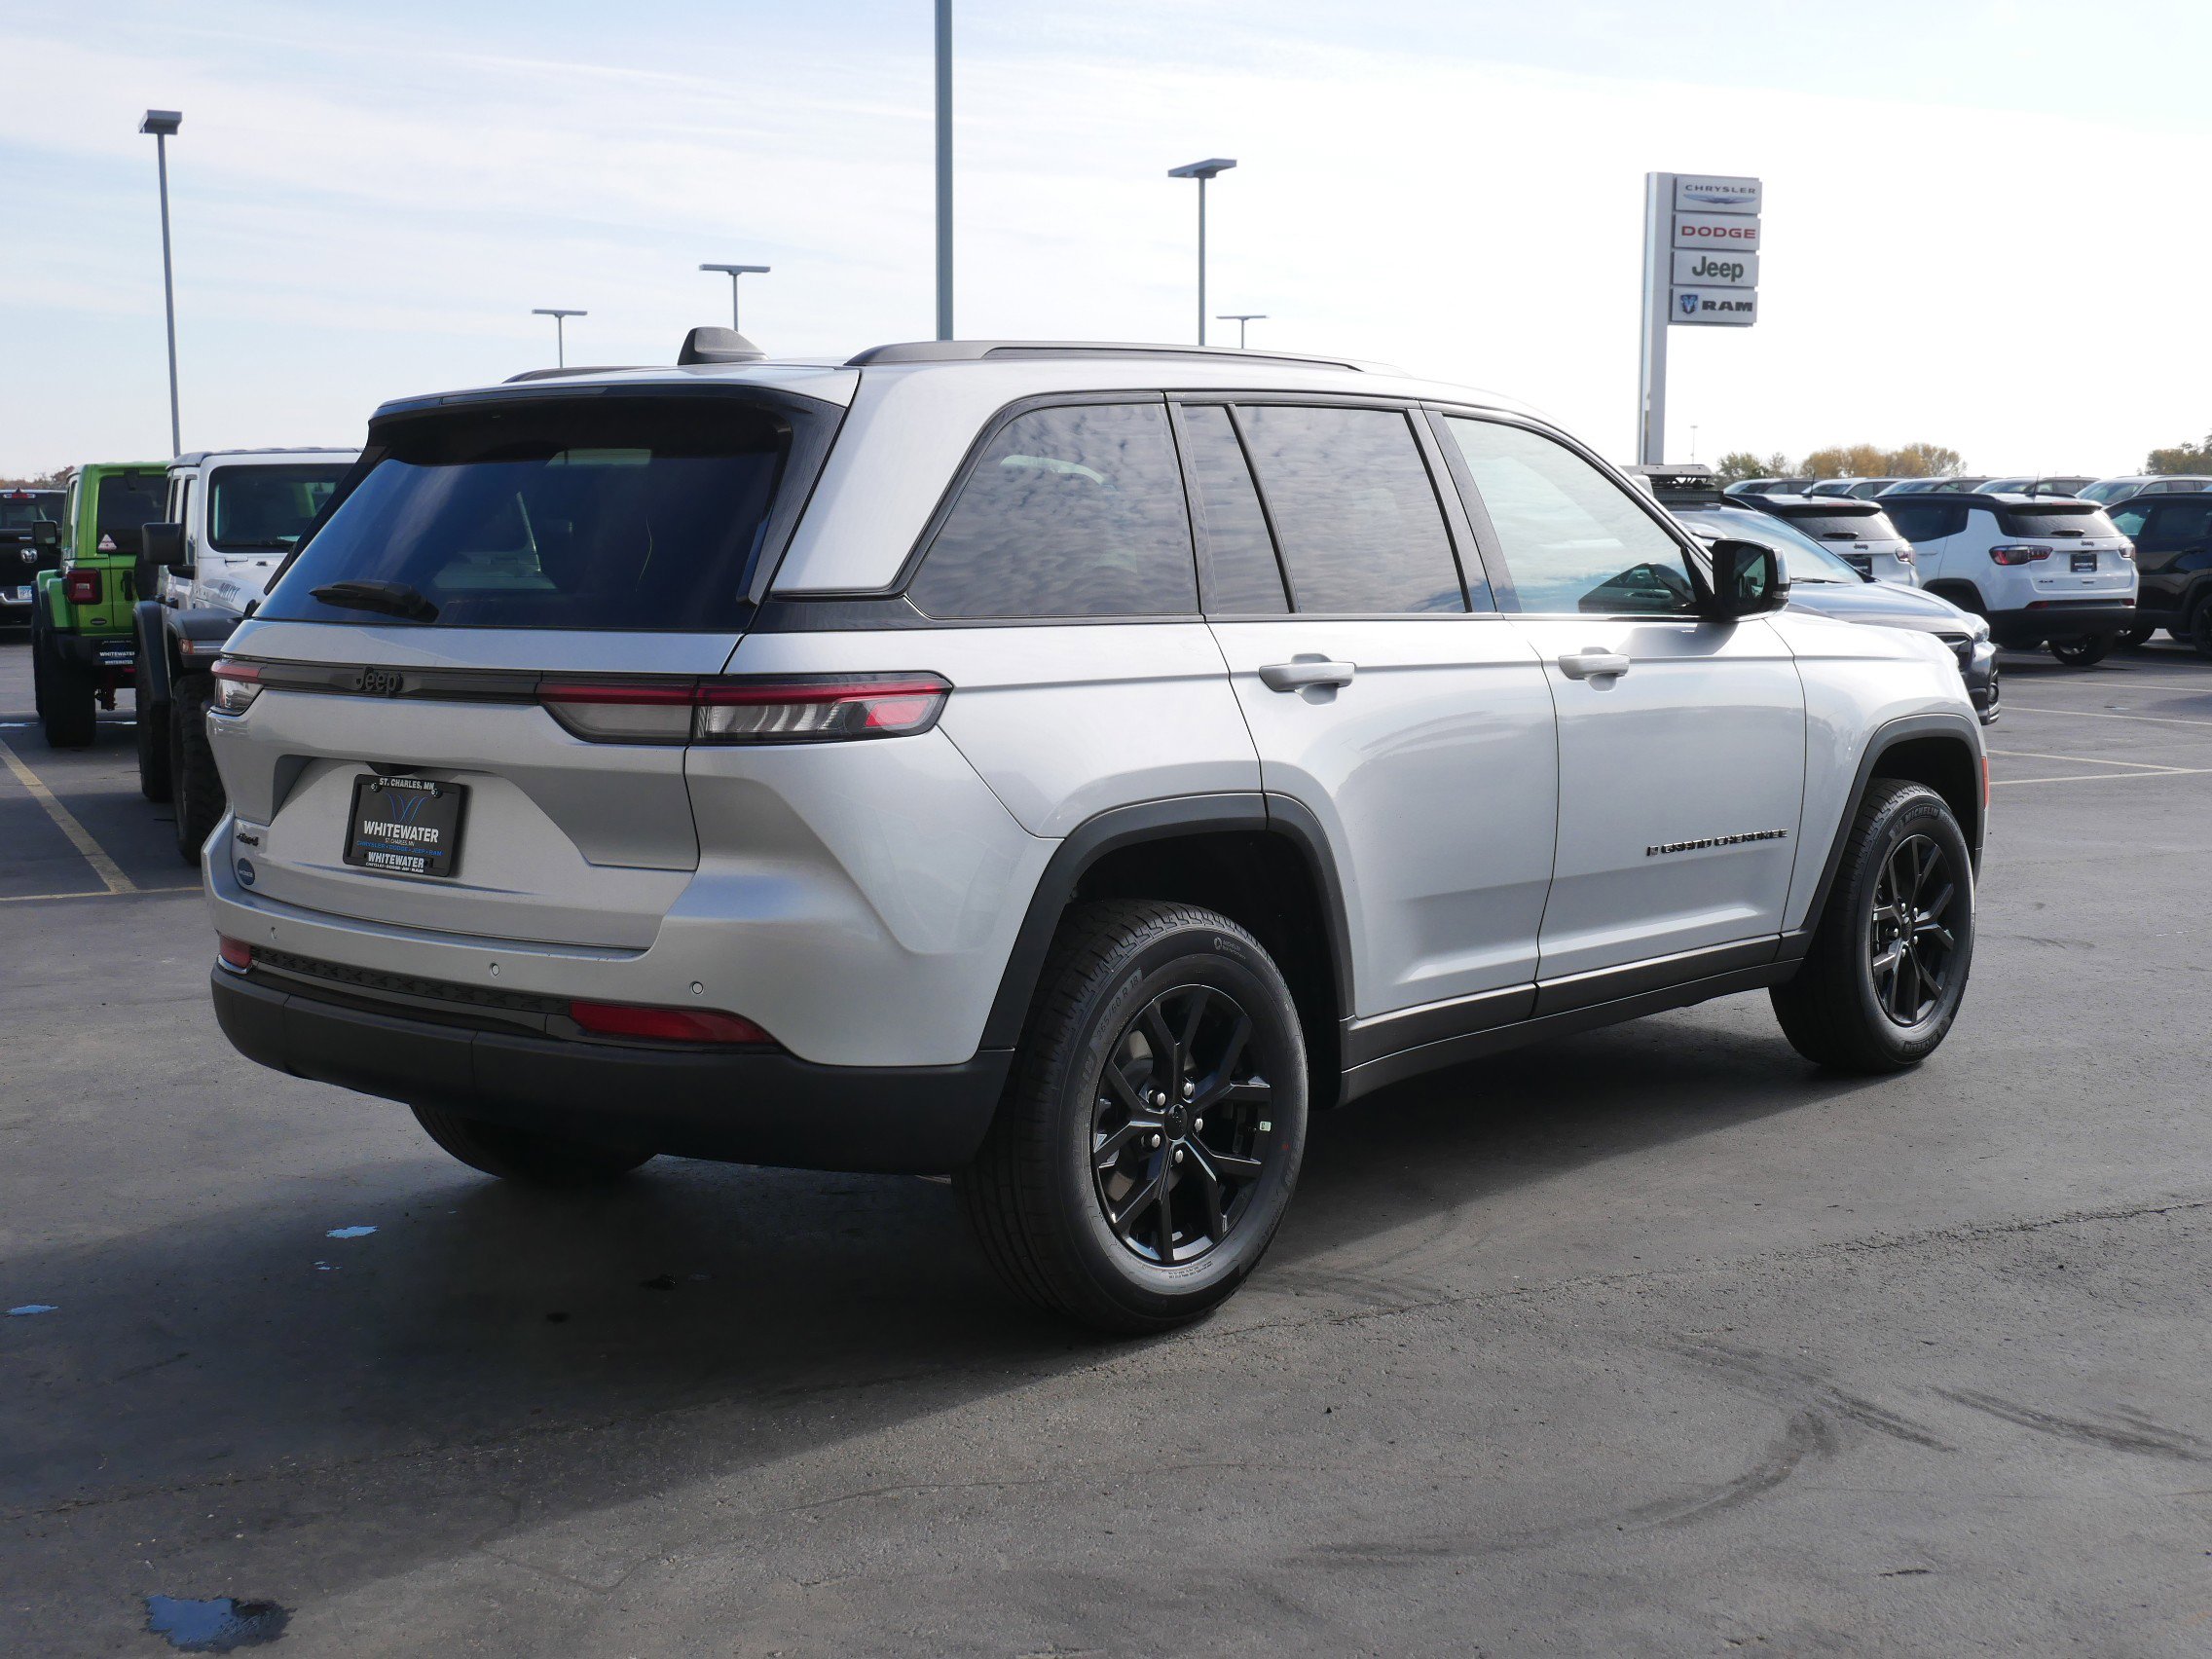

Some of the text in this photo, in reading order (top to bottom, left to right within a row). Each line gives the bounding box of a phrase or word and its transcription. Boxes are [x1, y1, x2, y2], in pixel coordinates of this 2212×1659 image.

[1685, 184, 1755, 194] CHRYSLER
[1681, 226, 1755, 239] DODGE
[1692, 256, 1744, 282] Jeep
[1702, 300, 1752, 312] RAM
[355, 666, 402, 696] Jeep
[379, 777, 434, 791] ST. CHARLES, MN
[1905, 806, 1939, 824] MICHELIN
[363, 820, 439, 843] WHITEWATER
[1661, 829, 1788, 853] GRAND CHEROKEE
[368, 851, 424, 869] WHITEWATER
